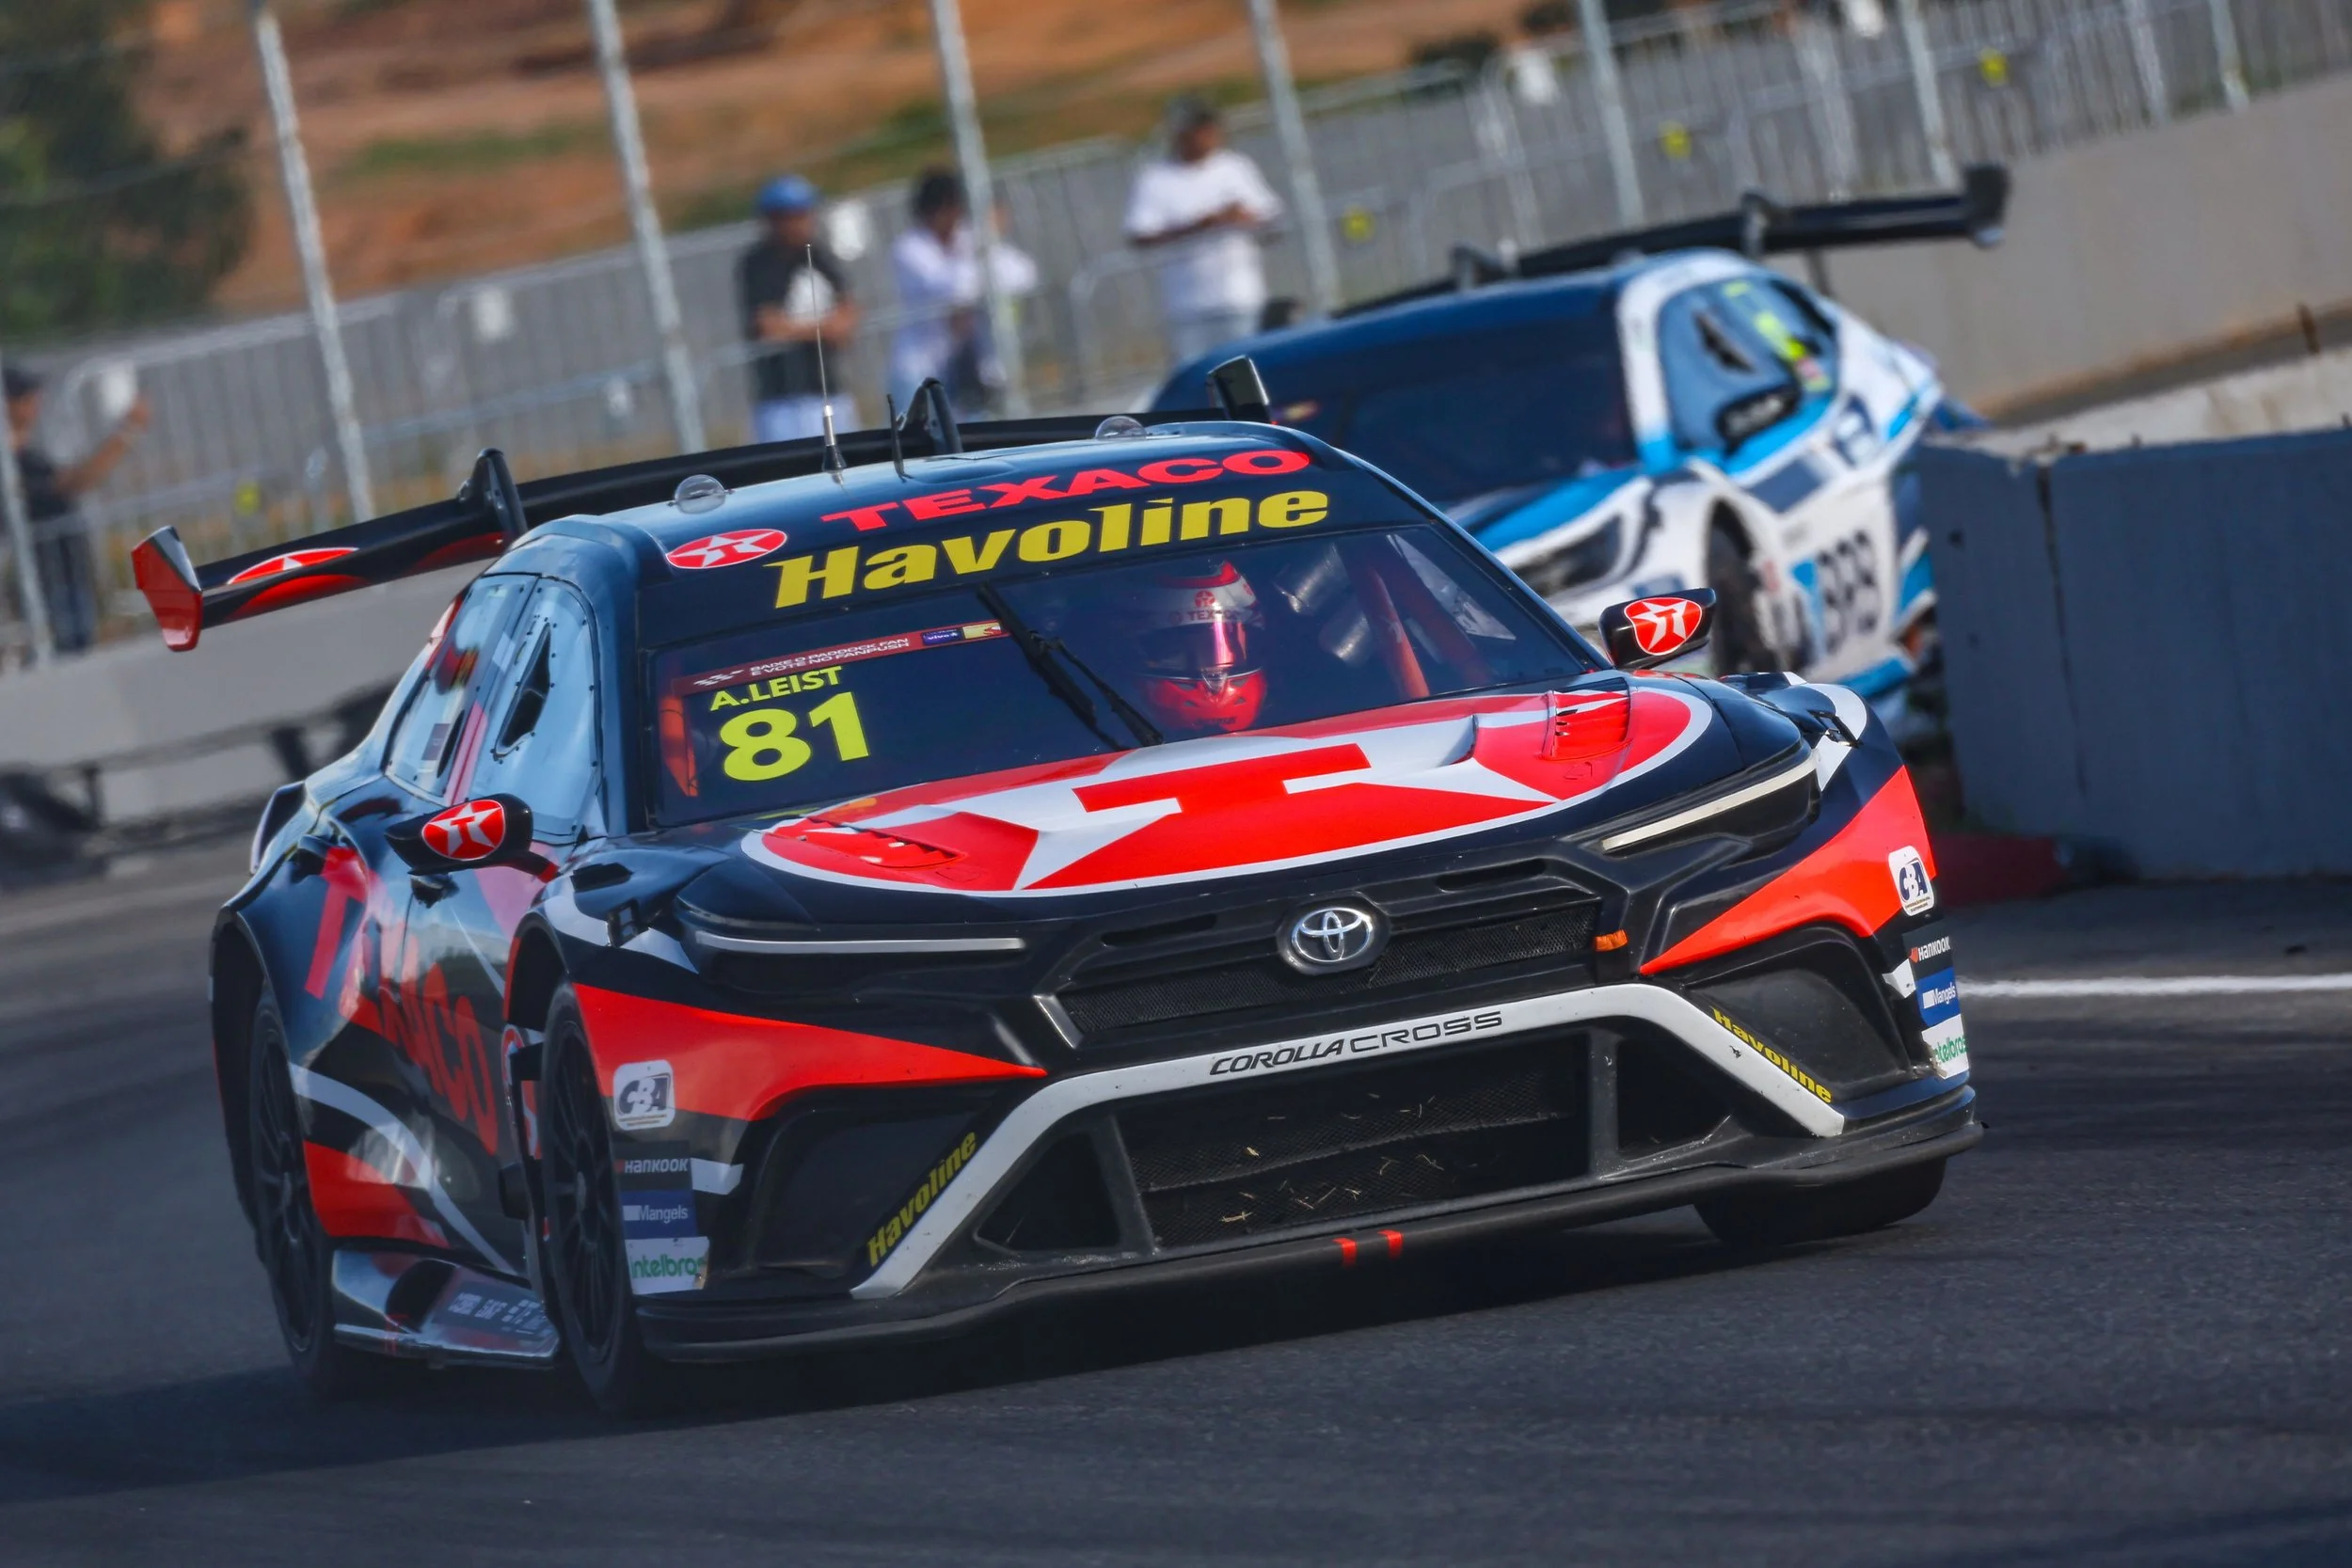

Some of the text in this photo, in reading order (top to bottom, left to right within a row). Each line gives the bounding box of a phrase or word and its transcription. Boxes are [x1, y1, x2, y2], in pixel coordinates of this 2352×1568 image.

[821, 450, 1311, 531] TEXACO
[764, 490, 1328, 609] Havoline
[808, 644, 875, 659] PADDOCK
[880, 638, 909, 647] FAN
[809, 656, 833, 665] NO
[835, 641, 910, 659] FANPUSH
[709, 666, 843, 711] A.LEIST
[720, 691, 870, 782] 81
[1933, 981, 1956, 1005] Mangels
[1209, 1010, 1504, 1076] COROLLA CROSS
[1710, 1006, 1832, 1103] Havoline
[639, 1204, 689, 1224] Mangels
[867, 1131, 977, 1266] Havoline
